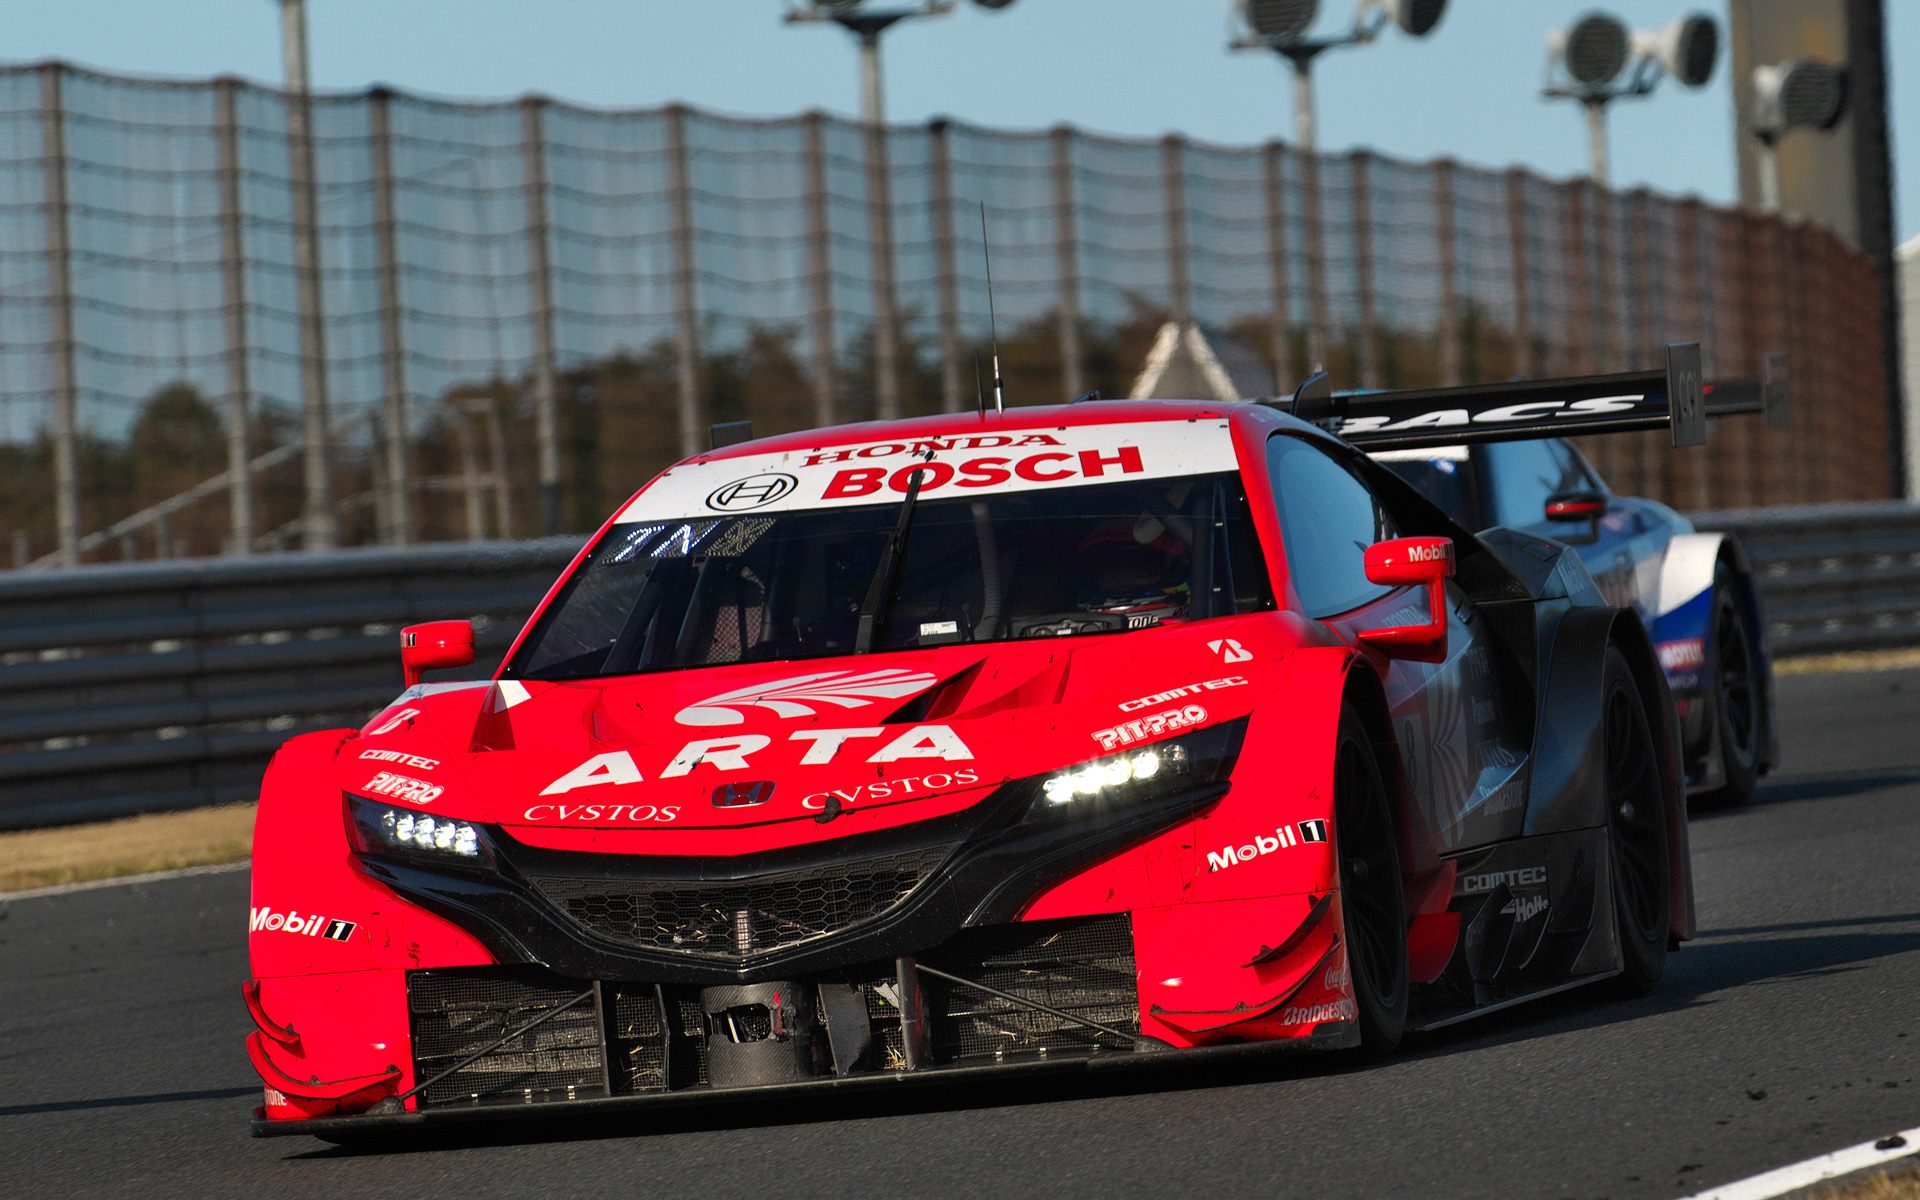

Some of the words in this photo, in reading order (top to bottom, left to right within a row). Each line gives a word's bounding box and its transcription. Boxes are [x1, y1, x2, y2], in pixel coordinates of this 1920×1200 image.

[799, 434, 1066, 468] HONDA
[821, 446, 1144, 500] BOSCH
[1408, 544, 1446, 562] Mobil
[1118, 676, 1248, 712] COMTEC
[359, 749, 439, 770] COMTEC
[539, 725, 975, 796] ARTA
[802, 768, 979, 810] CVSTOS
[524, 804, 681, 822] CVSTOS
[1207, 825, 1297, 872] Mobil
[1303, 819, 1323, 842] 1
[1463, 866, 1547, 892] COMTEC
[250, 907, 324, 936] Mobil
[328, 921, 350, 941] 1
